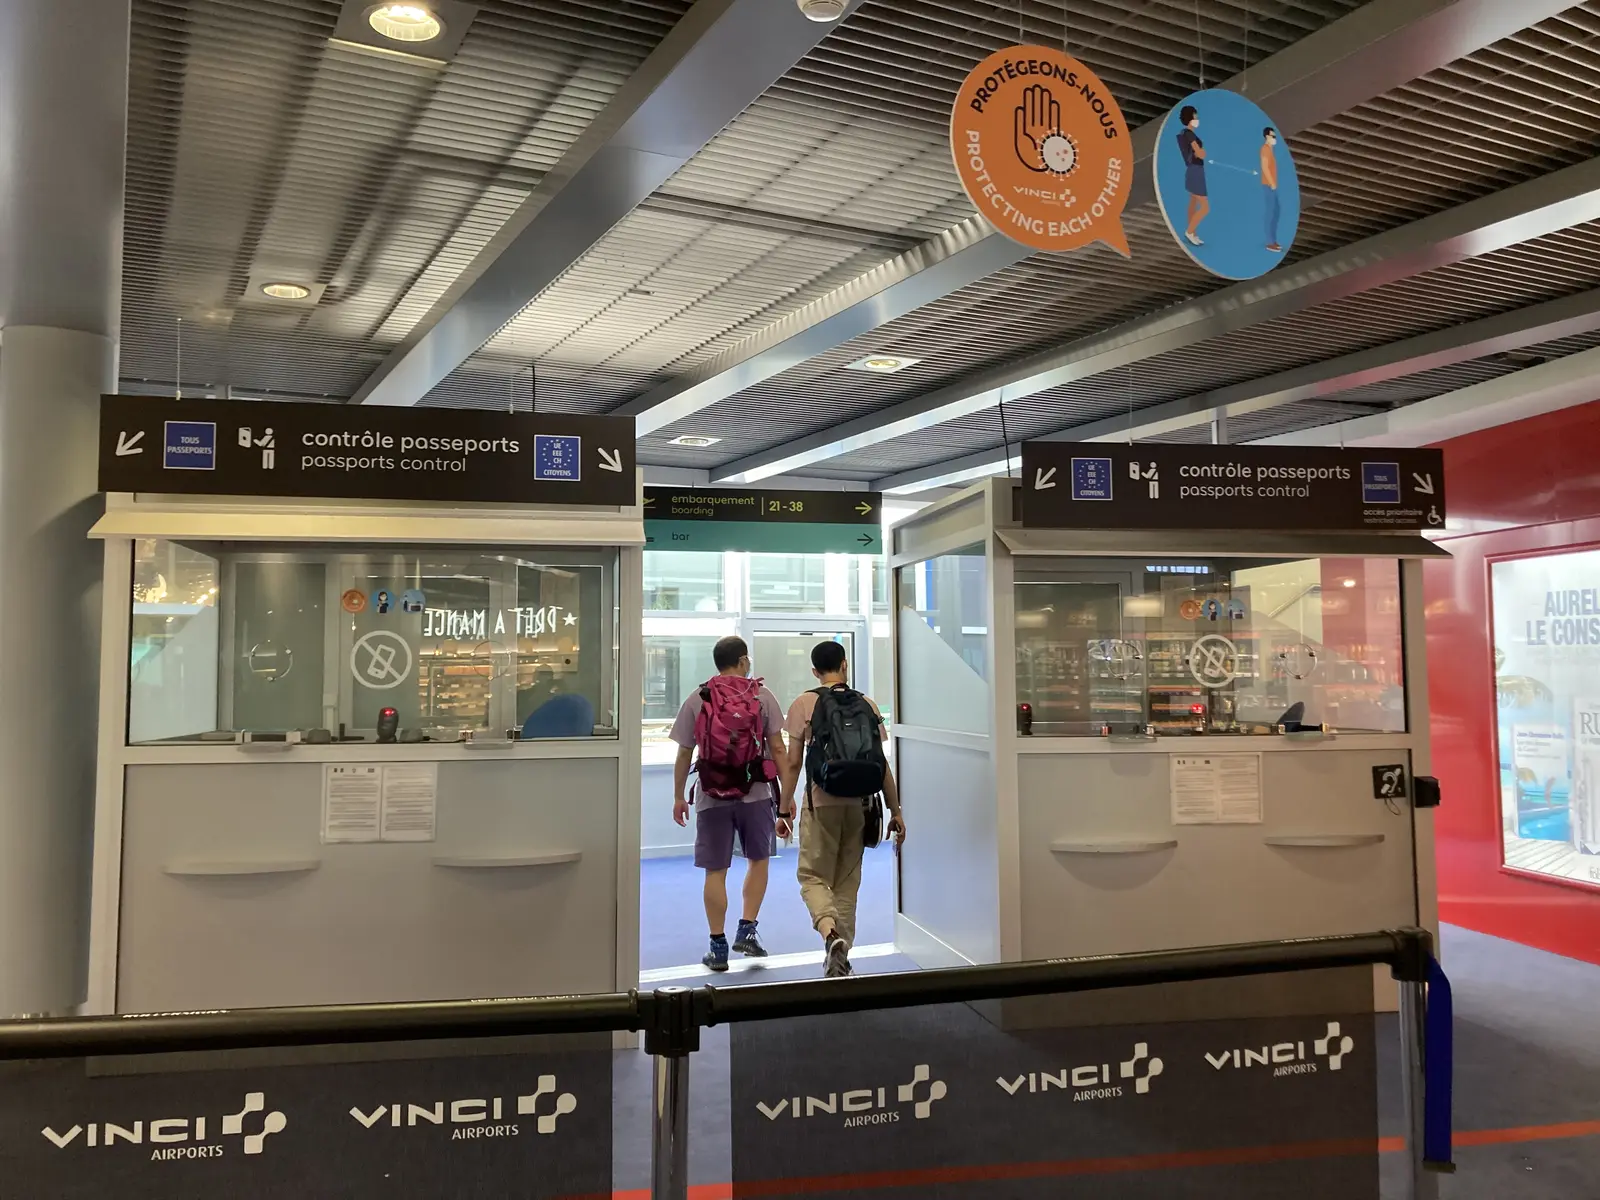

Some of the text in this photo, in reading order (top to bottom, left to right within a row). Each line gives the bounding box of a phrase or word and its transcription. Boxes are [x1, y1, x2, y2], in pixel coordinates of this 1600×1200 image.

[970, 59, 1118, 139] PROTÉGEONS-NOUS
[965, 129, 1122, 237] PROTECTING EACH OTHER
[1012, 185, 1056, 201] VINCI
[180, 436, 200, 444] TOUS
[301, 430, 520, 456] contrôle passeports
[167, 446, 213, 455] PASSEPORTS
[301, 455, 466, 472] passports control
[1179, 462, 1351, 483] contrôle passeports
[1179, 484, 1310, 500] passports control
[671, 494, 755, 506] embarquement
[769, 501, 780, 512] 21
[789, 501, 804, 512] 38
[671, 506, 714, 517] boarding
[671, 532, 690, 541] bar
[1544, 588, 1600, 617] AUREL
[1526, 617, 1600, 646] LE CONS
[1204, 1041, 1305, 1070] VINCI
[1273, 1062, 1318, 1078] AIRPORTS
[996, 1064, 1110, 1096] VINCI
[1073, 1085, 1123, 1102] AIRPORTS
[349, 1097, 503, 1129] VINCI
[756, 1087, 885, 1121] VINCI
[843, 1110, 900, 1128] AIRPORTS
[41, 1117, 206, 1149] VINCI
[452, 1124, 519, 1141] AIRPORTS
[151, 1144, 224, 1161] AIRPORTS
